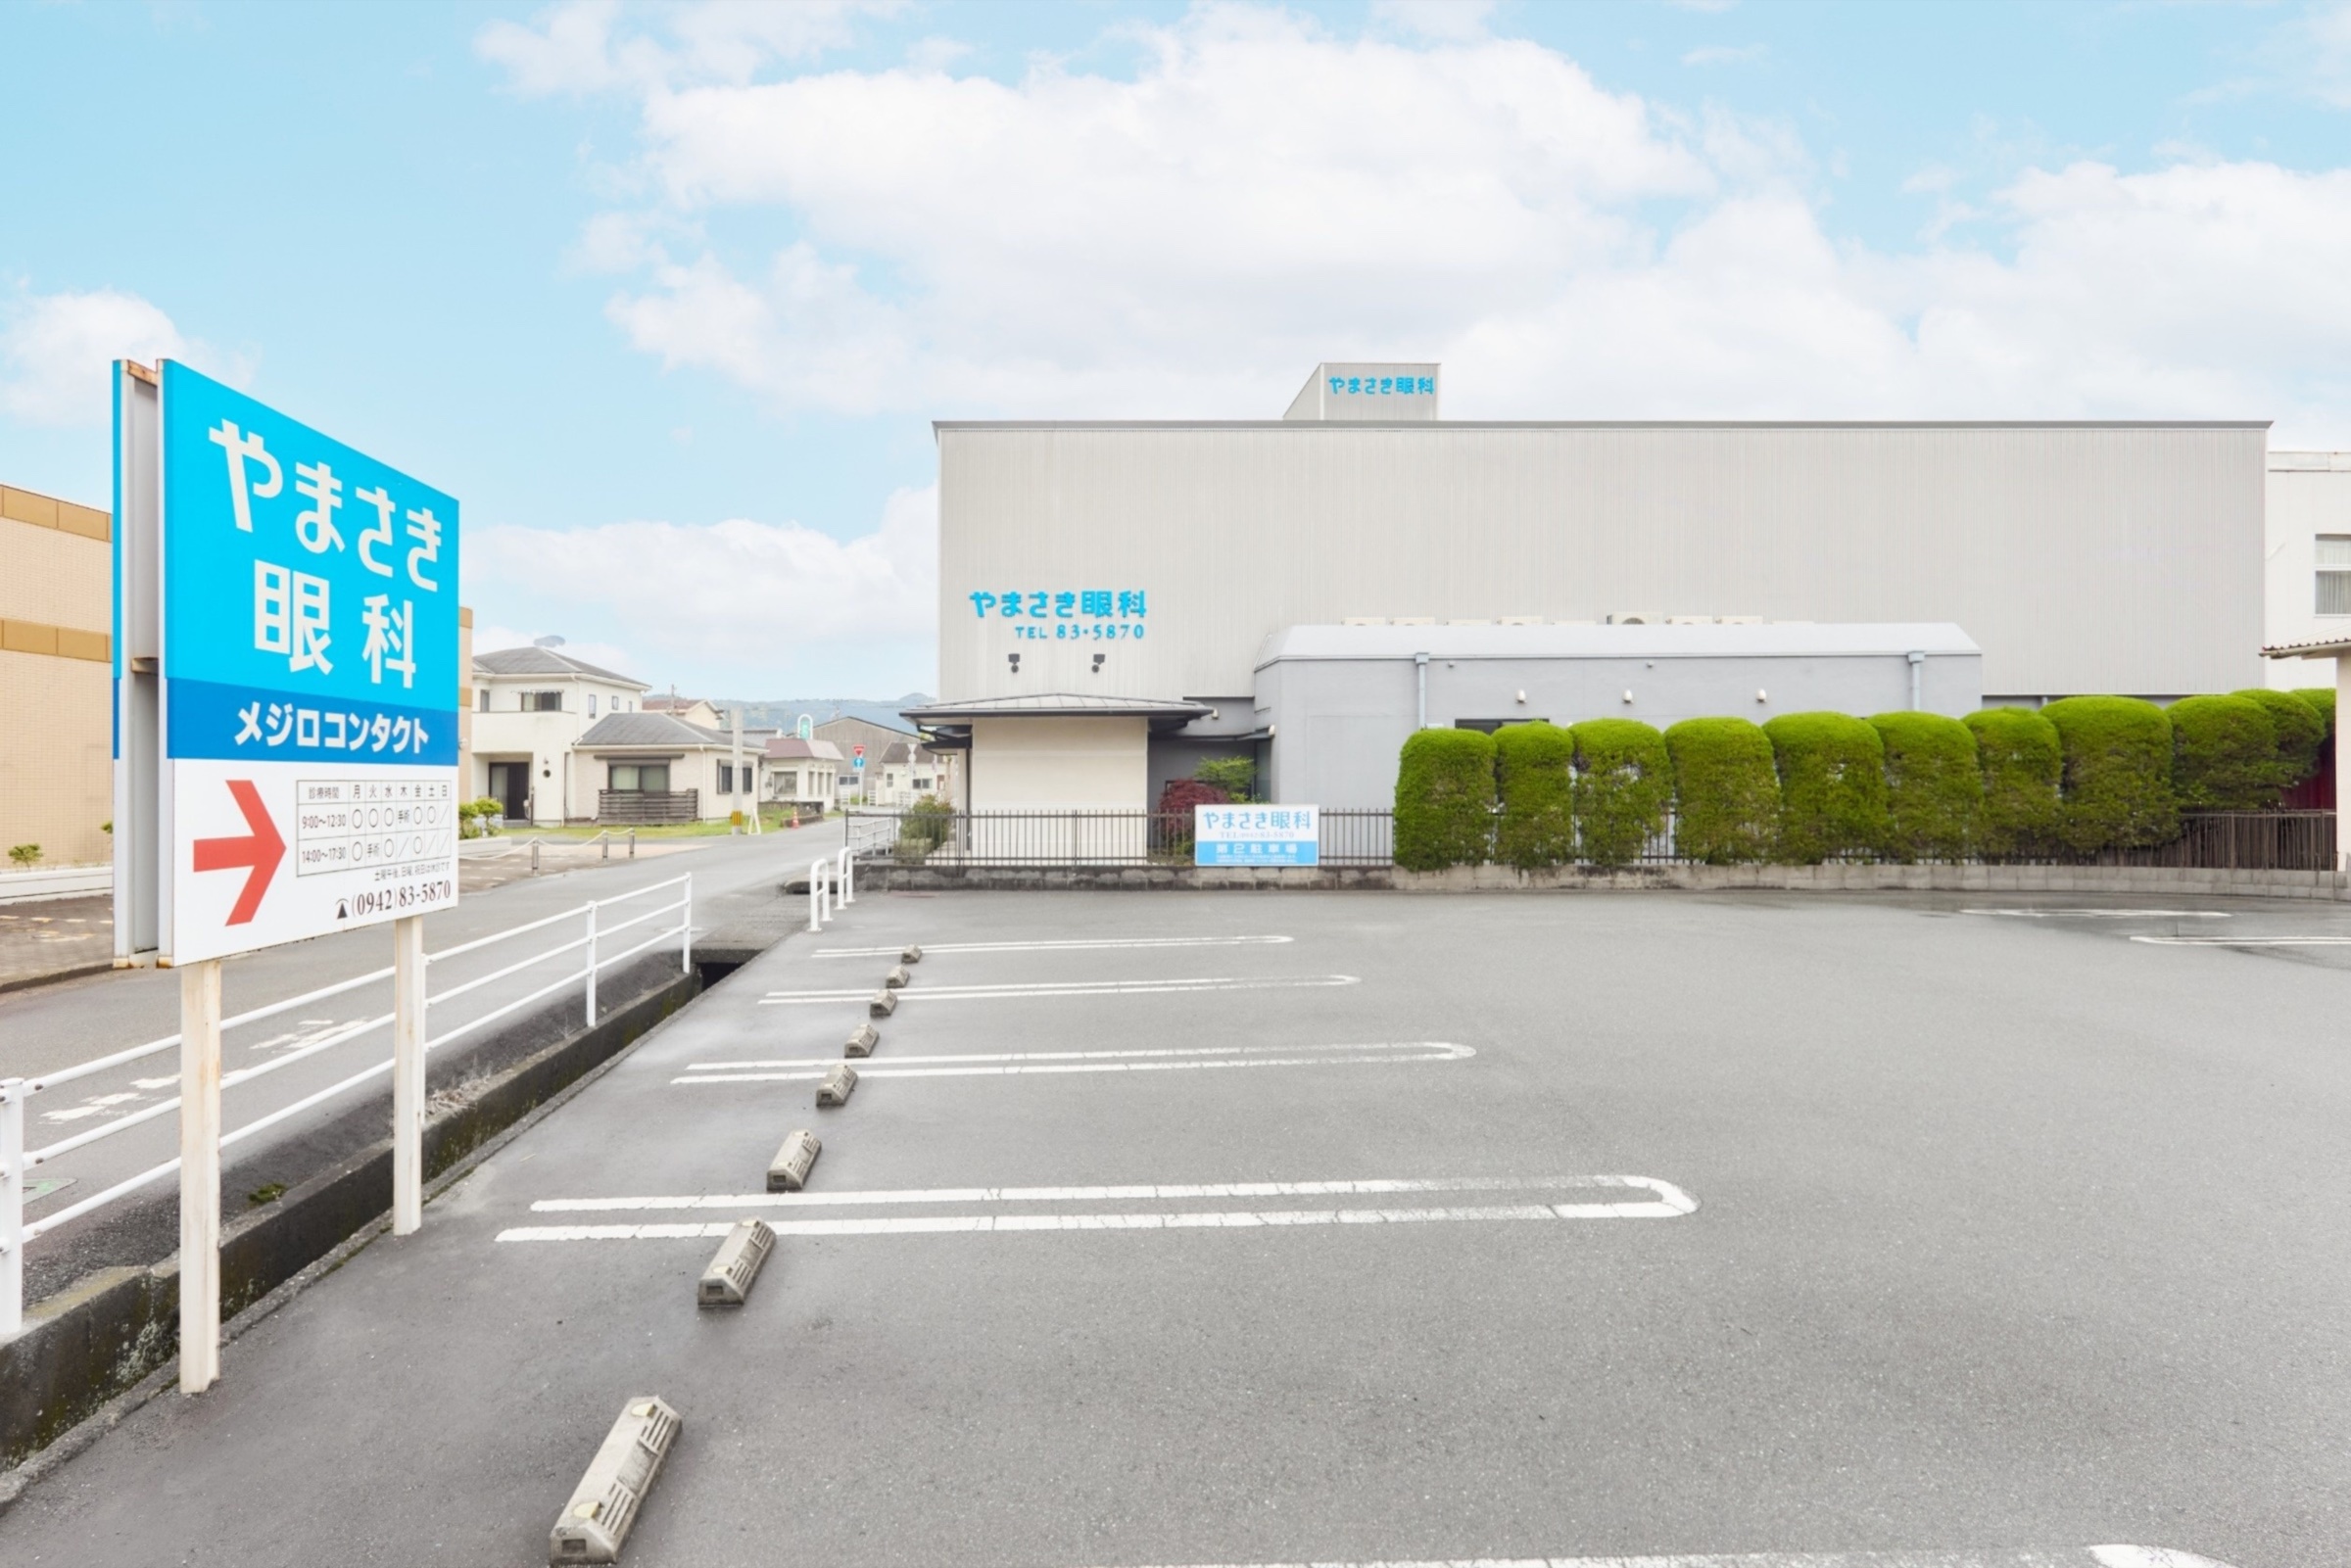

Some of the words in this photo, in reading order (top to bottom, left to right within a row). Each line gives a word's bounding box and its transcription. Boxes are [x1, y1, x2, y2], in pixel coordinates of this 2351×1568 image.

[1328, 376, 1434, 395] やまさき眼科
[209, 418, 442, 593] やまさき
[969, 591, 1146, 618] やまさき眼科
[254, 558, 416, 689] 眼科
[1015, 626, 1048, 640] TEL
[234, 701, 429, 754] メジロコンタクト
[353, 784, 360, 799] 月
[369, 784, 377, 798] 火
[385, 784, 393, 798] 水
[401, 784, 408, 797] 木
[414, 784, 421, 797] 金
[428, 784, 435, 797] 土
[442, 784, 448, 797] 日
[1203, 810, 1311, 830] やまさき眼科
